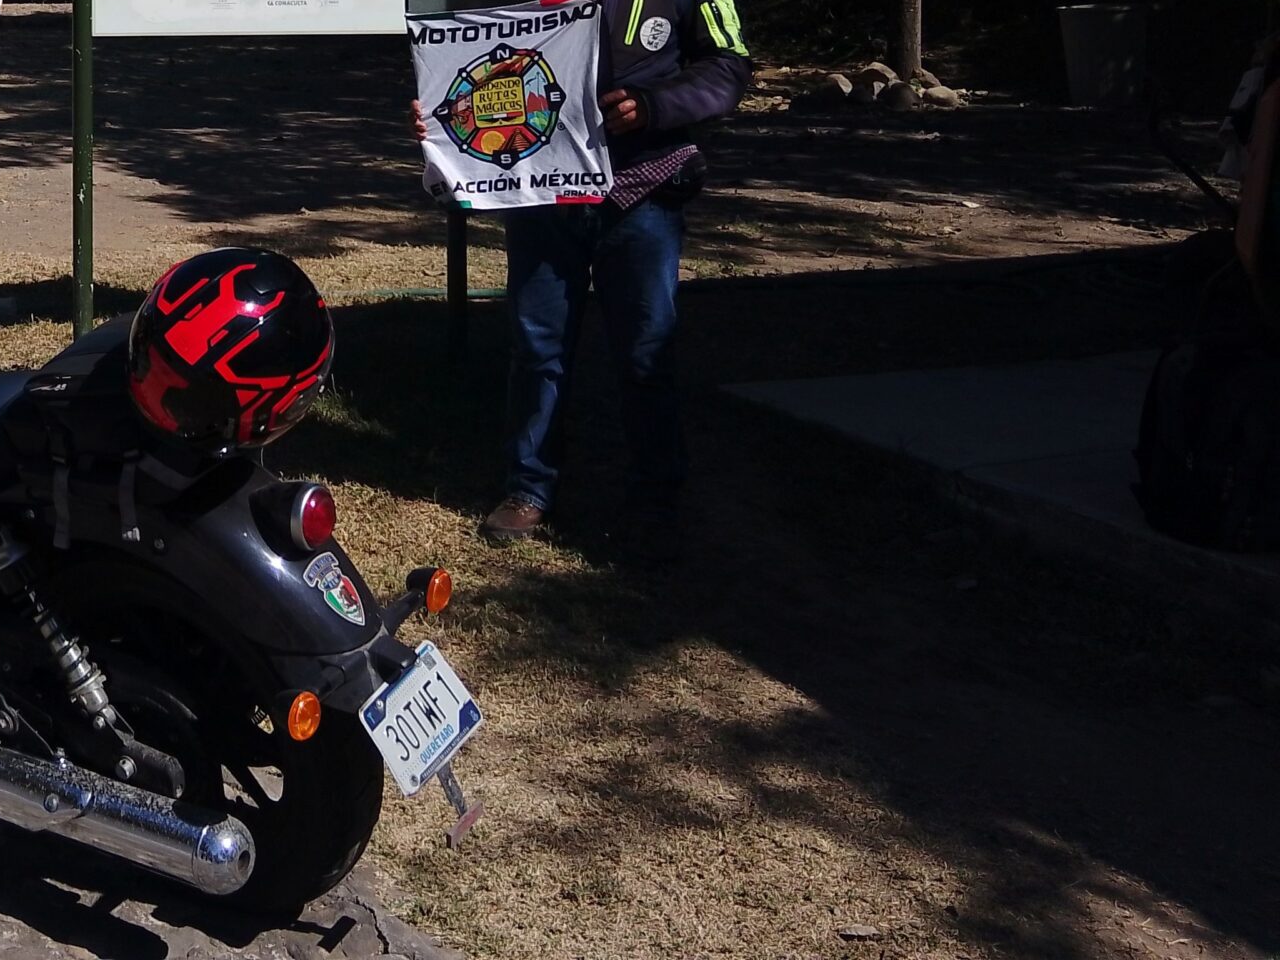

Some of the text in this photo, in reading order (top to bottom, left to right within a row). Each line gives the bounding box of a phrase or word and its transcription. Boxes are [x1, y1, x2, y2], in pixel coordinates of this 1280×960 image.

[408, 2, 598, 45] MOTOTURISMO
[496, 48, 510, 60] N
[549, 91, 561, 102] E
[500, 153, 512, 164] S
[453, 173, 521, 194] ACCIÓN
[529, 168, 607, 188] MÉXICO
